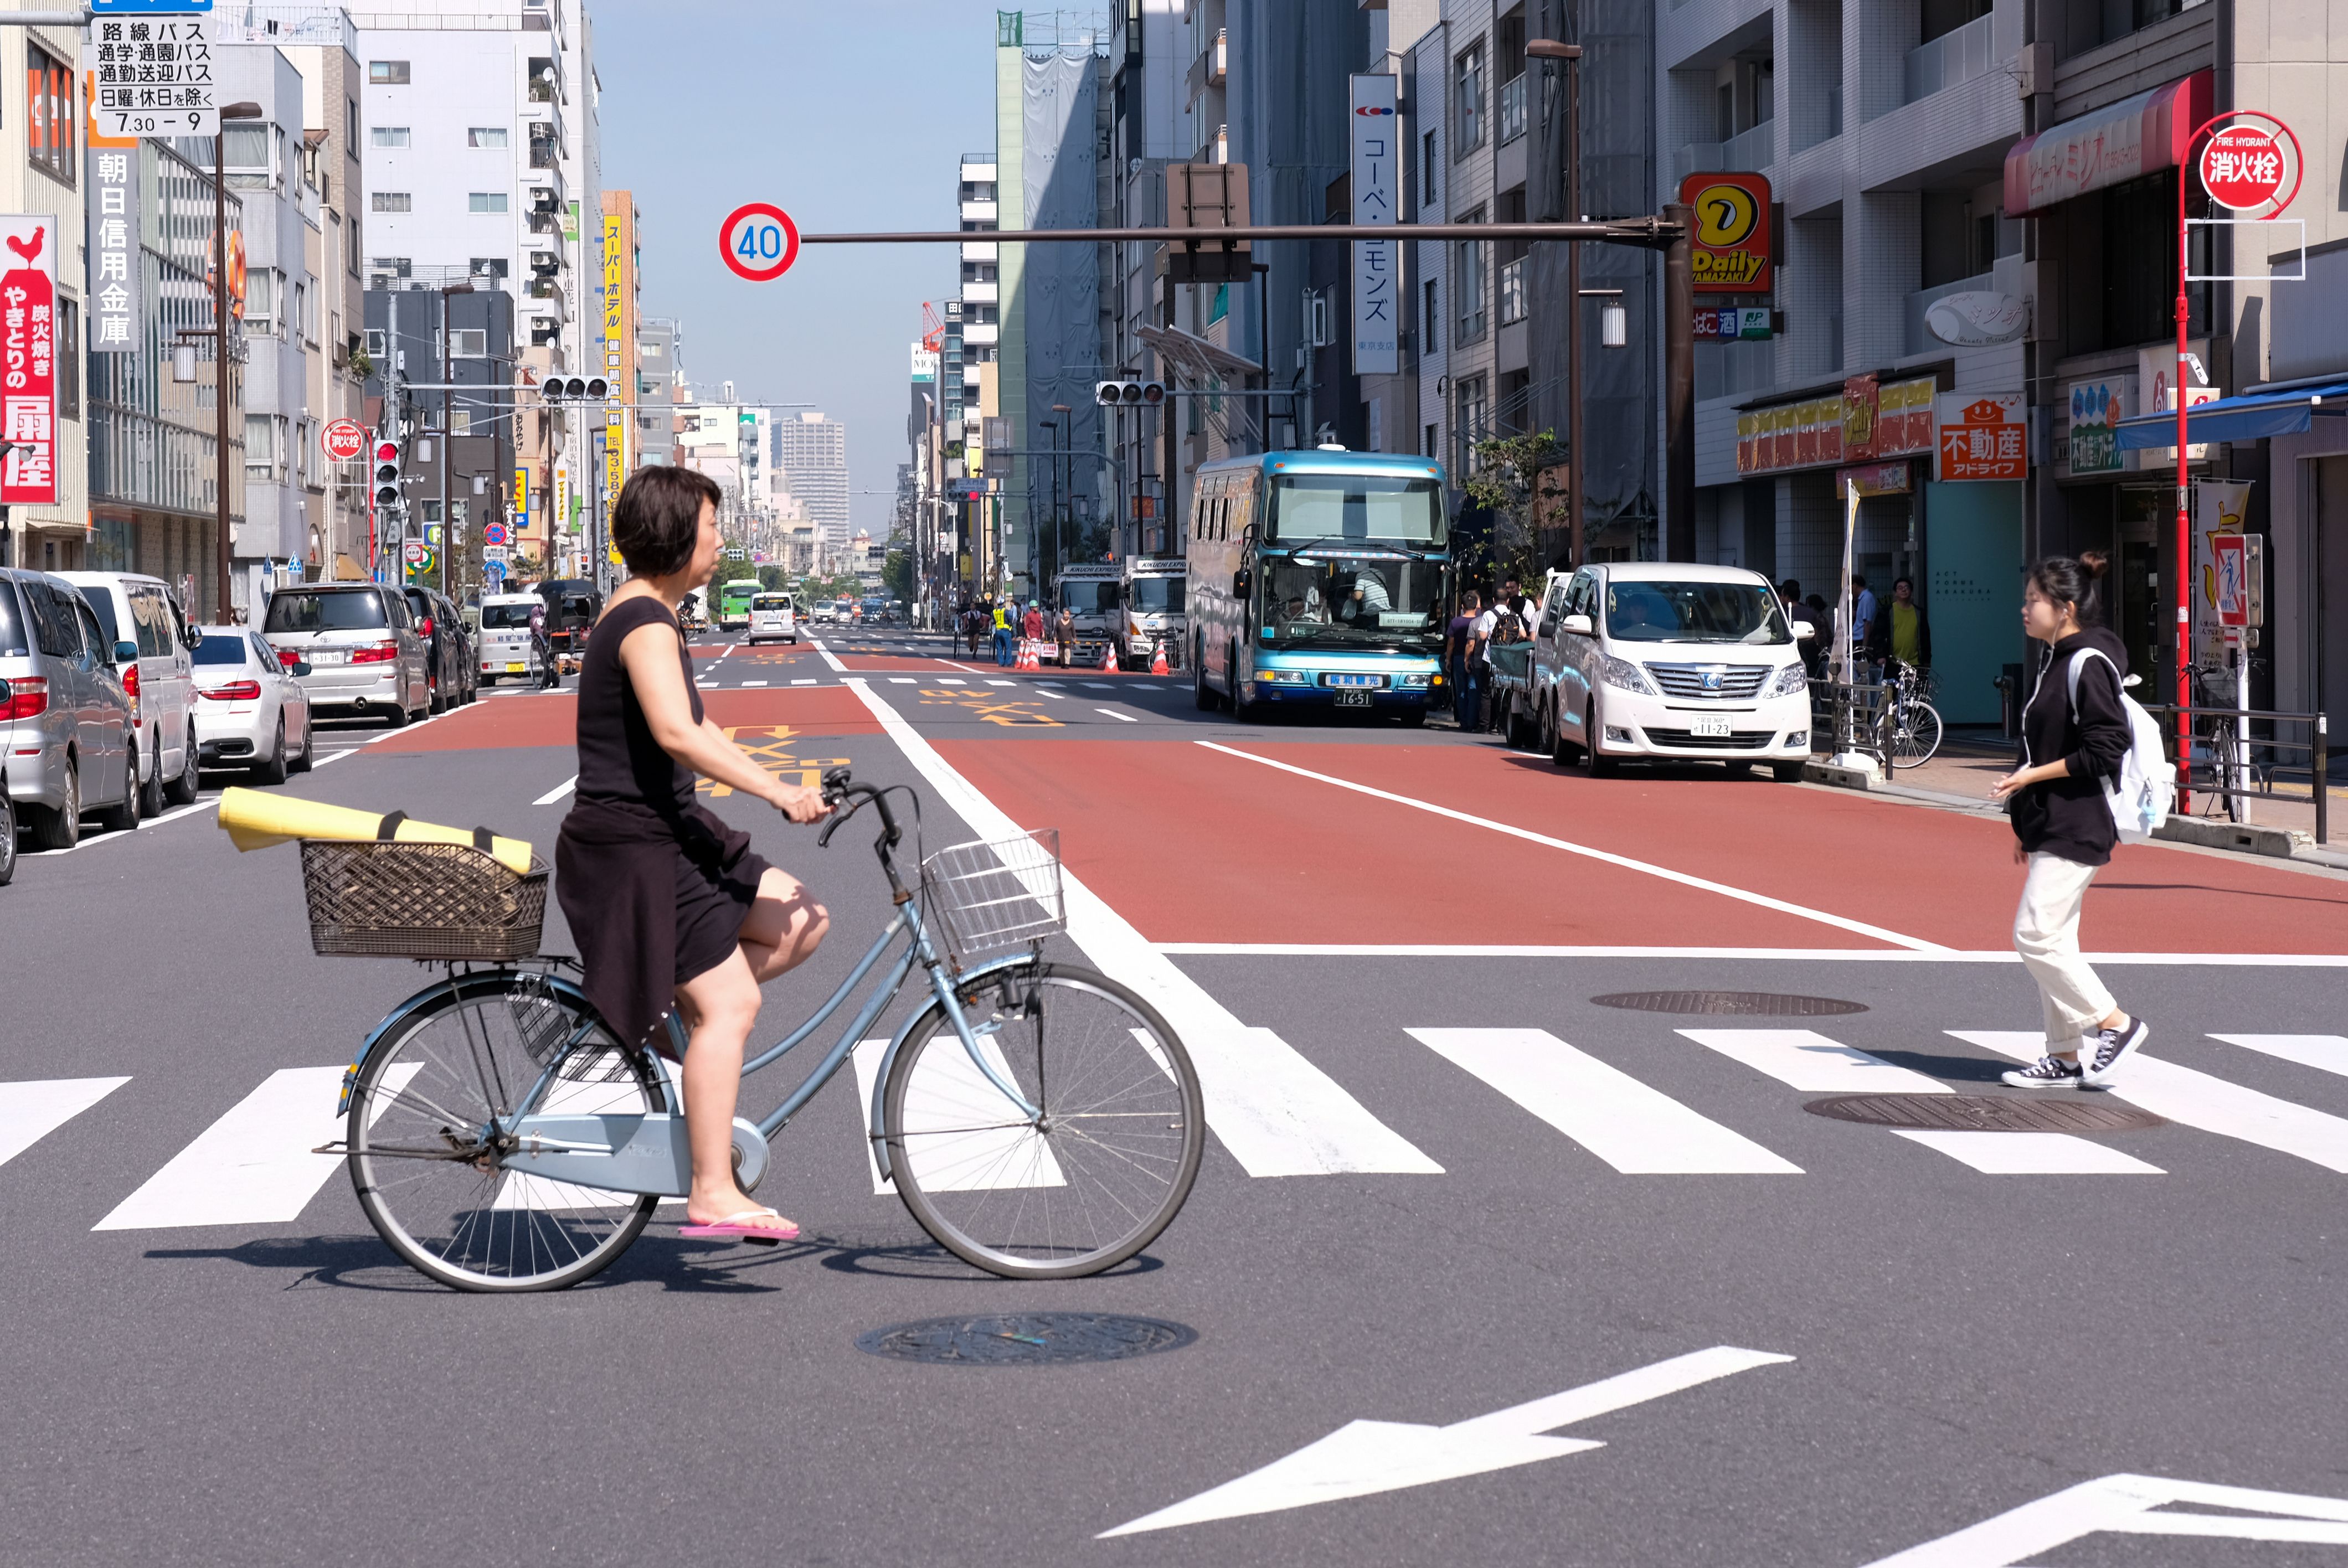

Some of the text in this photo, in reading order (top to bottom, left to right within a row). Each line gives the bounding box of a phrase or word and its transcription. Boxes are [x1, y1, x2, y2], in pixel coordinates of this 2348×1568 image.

[103, 22, 204, 42] 路線バス
[98, 43, 211, 62] 通学・通園バス
[99, 64, 212, 82] 通勤送迎バス
[101, 87, 213, 107] 日曜・休日を除く
[188, 112, 200, 131] 9
[2217, 137, 2272, 147] FIRE HYDRANT
[2209, 151, 2279, 184] 消火栓
[97, 153, 131, 345] 朝日信用金庫
[738, 225, 781, 259] 40
[1693, 250, 1764, 282] Daily
[606, 226, 620, 328] スーパーホテル
[1719, 312, 1736, 334] 酒
[4, 286, 27, 389] やきとりの
[31, 305, 50, 376] 炭火焼き
[1358, 341, 1394, 350] 東京支店
[4, 395, 52, 487] 扇屋
[331, 434, 359, 448] 消火栓
[609, 437, 620, 446] TEL
[1943, 427, 2023, 461] 不動産
[2073, 434, 2094, 468] 不動産
[1953, 462, 2015, 476] アドライフ
[1330, 675, 1378, 685] 阪和観光
[1343, 693, 1369, 705] 16-51
[1701, 724, 1729, 734] 11-23
